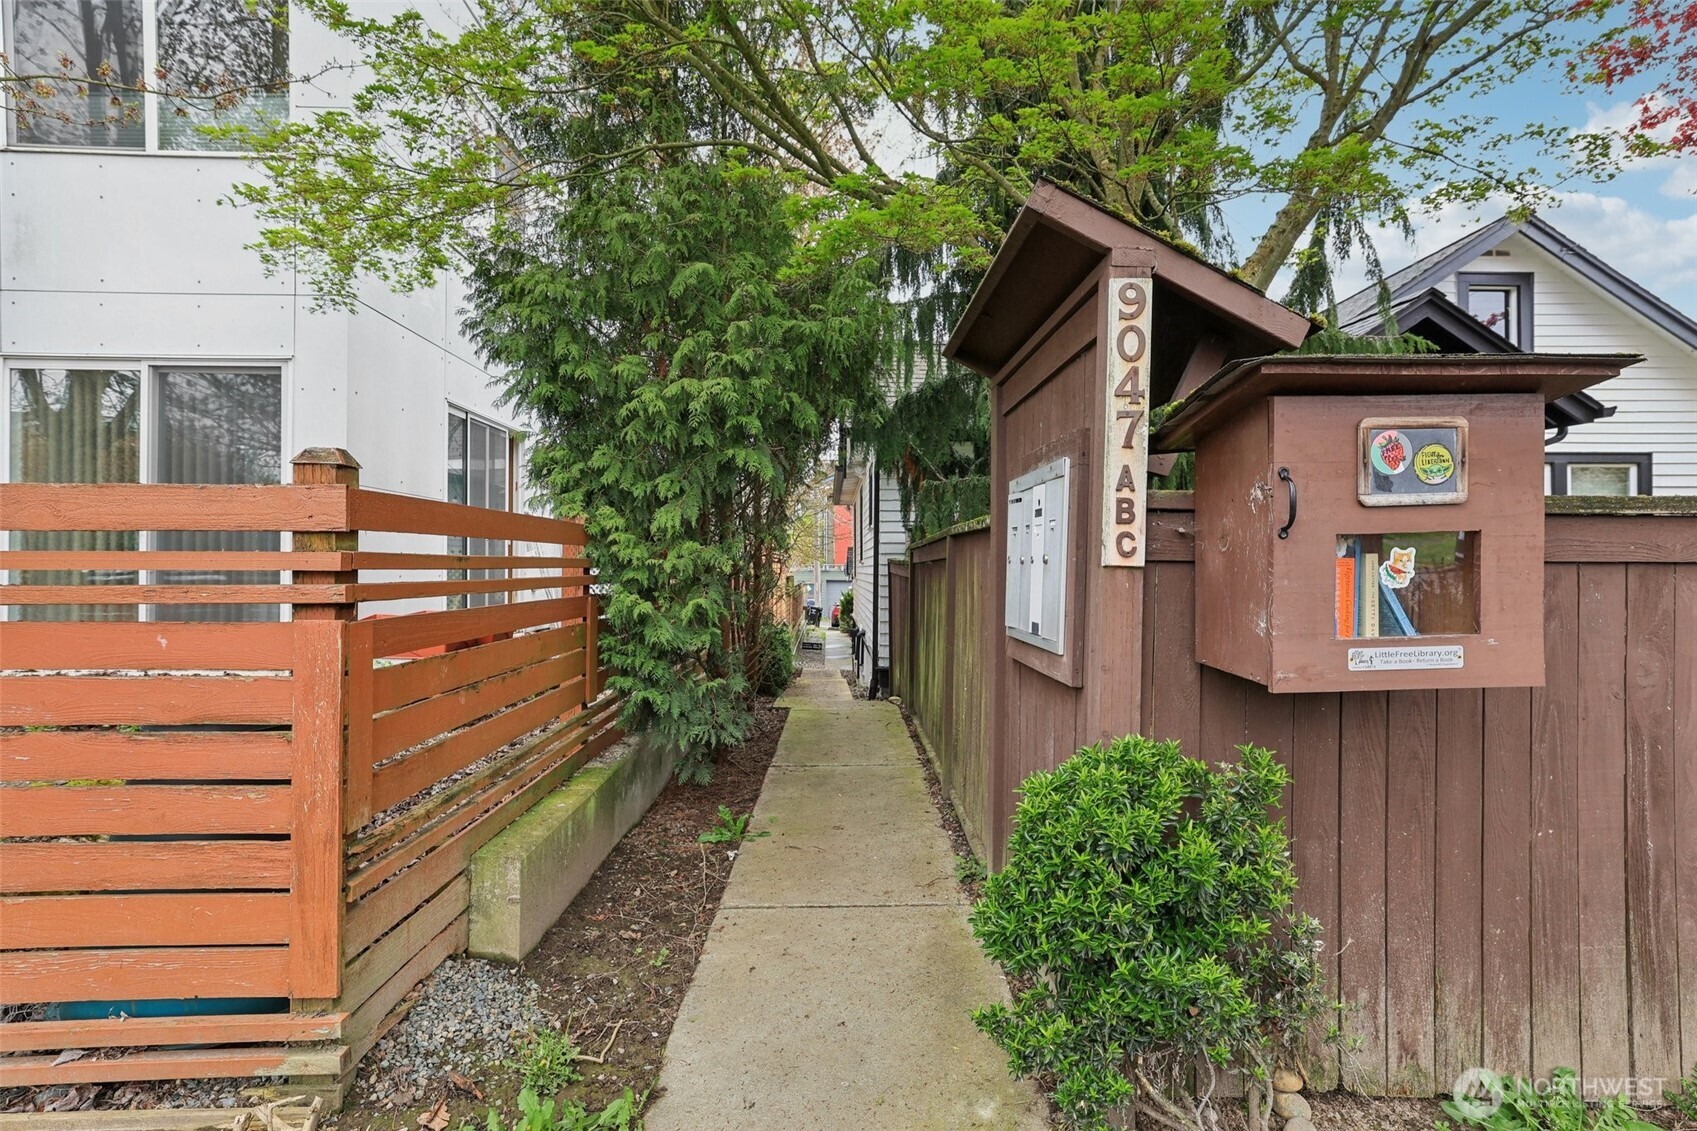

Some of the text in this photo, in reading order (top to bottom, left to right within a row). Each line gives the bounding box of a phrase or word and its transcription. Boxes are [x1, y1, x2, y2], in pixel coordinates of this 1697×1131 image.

[1114, 281, 1147, 559] 9047 ABC
[1374, 649, 1458, 659] LittleFreeLibrary.org
